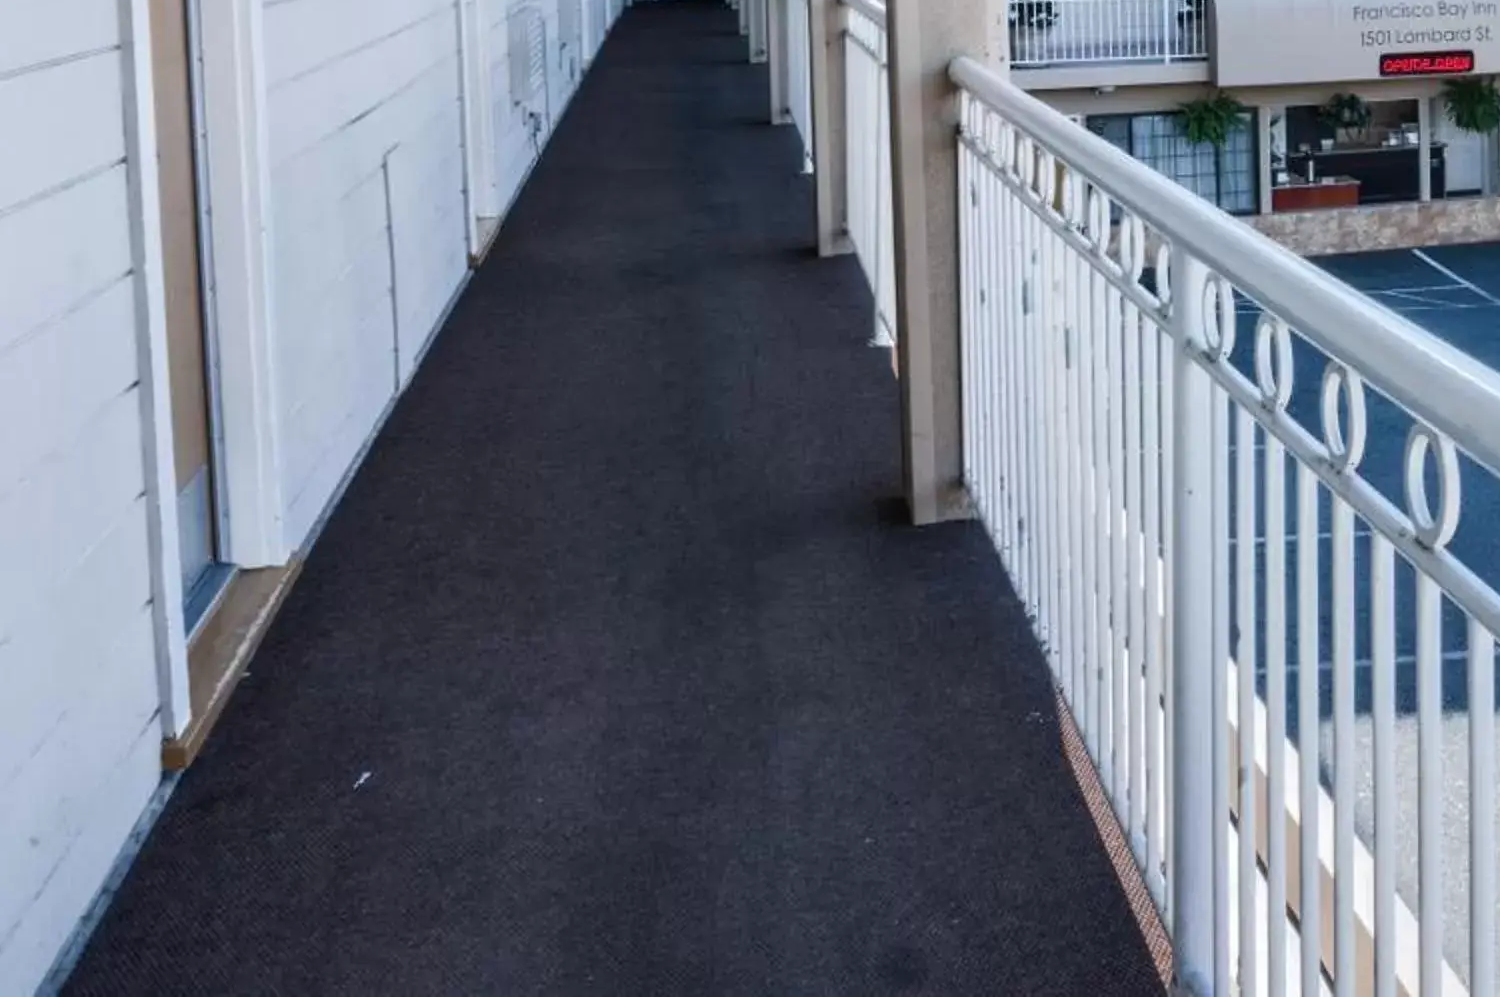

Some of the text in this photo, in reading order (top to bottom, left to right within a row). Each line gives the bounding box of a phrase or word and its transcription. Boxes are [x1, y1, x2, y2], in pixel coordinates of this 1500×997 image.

[1352, 0, 1497, 21] Francisco Bay Inn
[1361, 29, 1392, 47] 1501
[1396, 27, 1471, 44] Lombard
